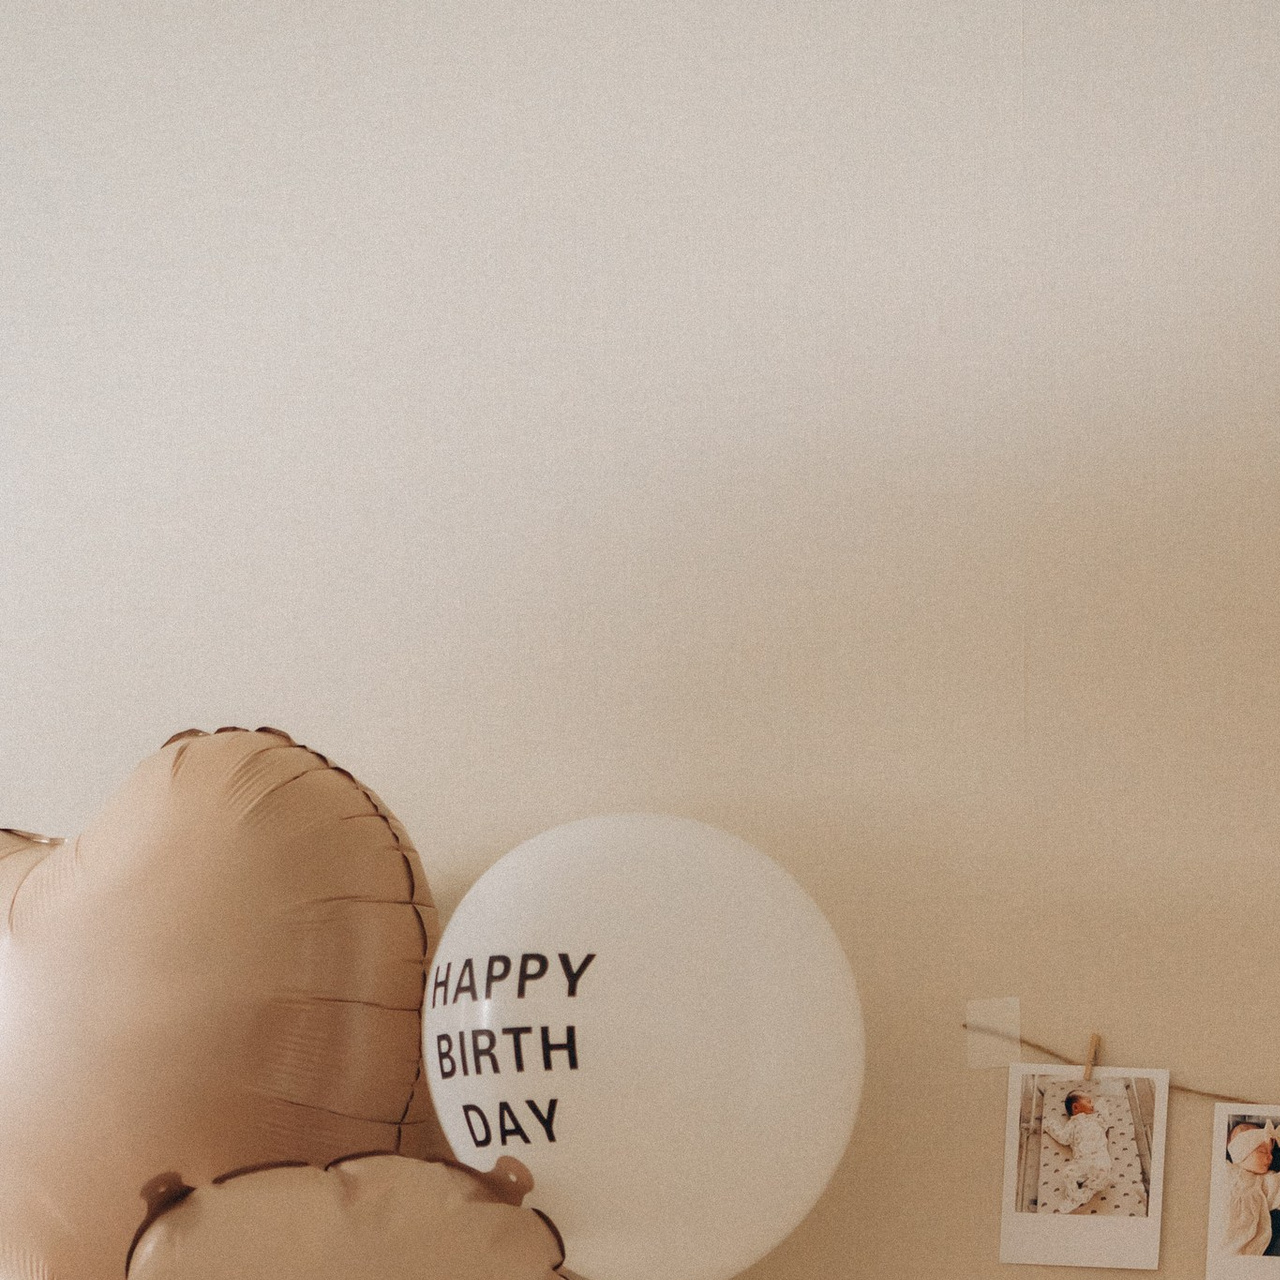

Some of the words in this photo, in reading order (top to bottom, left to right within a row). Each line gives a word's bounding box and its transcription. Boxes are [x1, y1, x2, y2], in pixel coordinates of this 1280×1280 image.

[431, 952, 597, 1009] HAPPY
[436, 1025, 579, 1080] BIRTH
[462, 1098, 559, 1148] DAY
